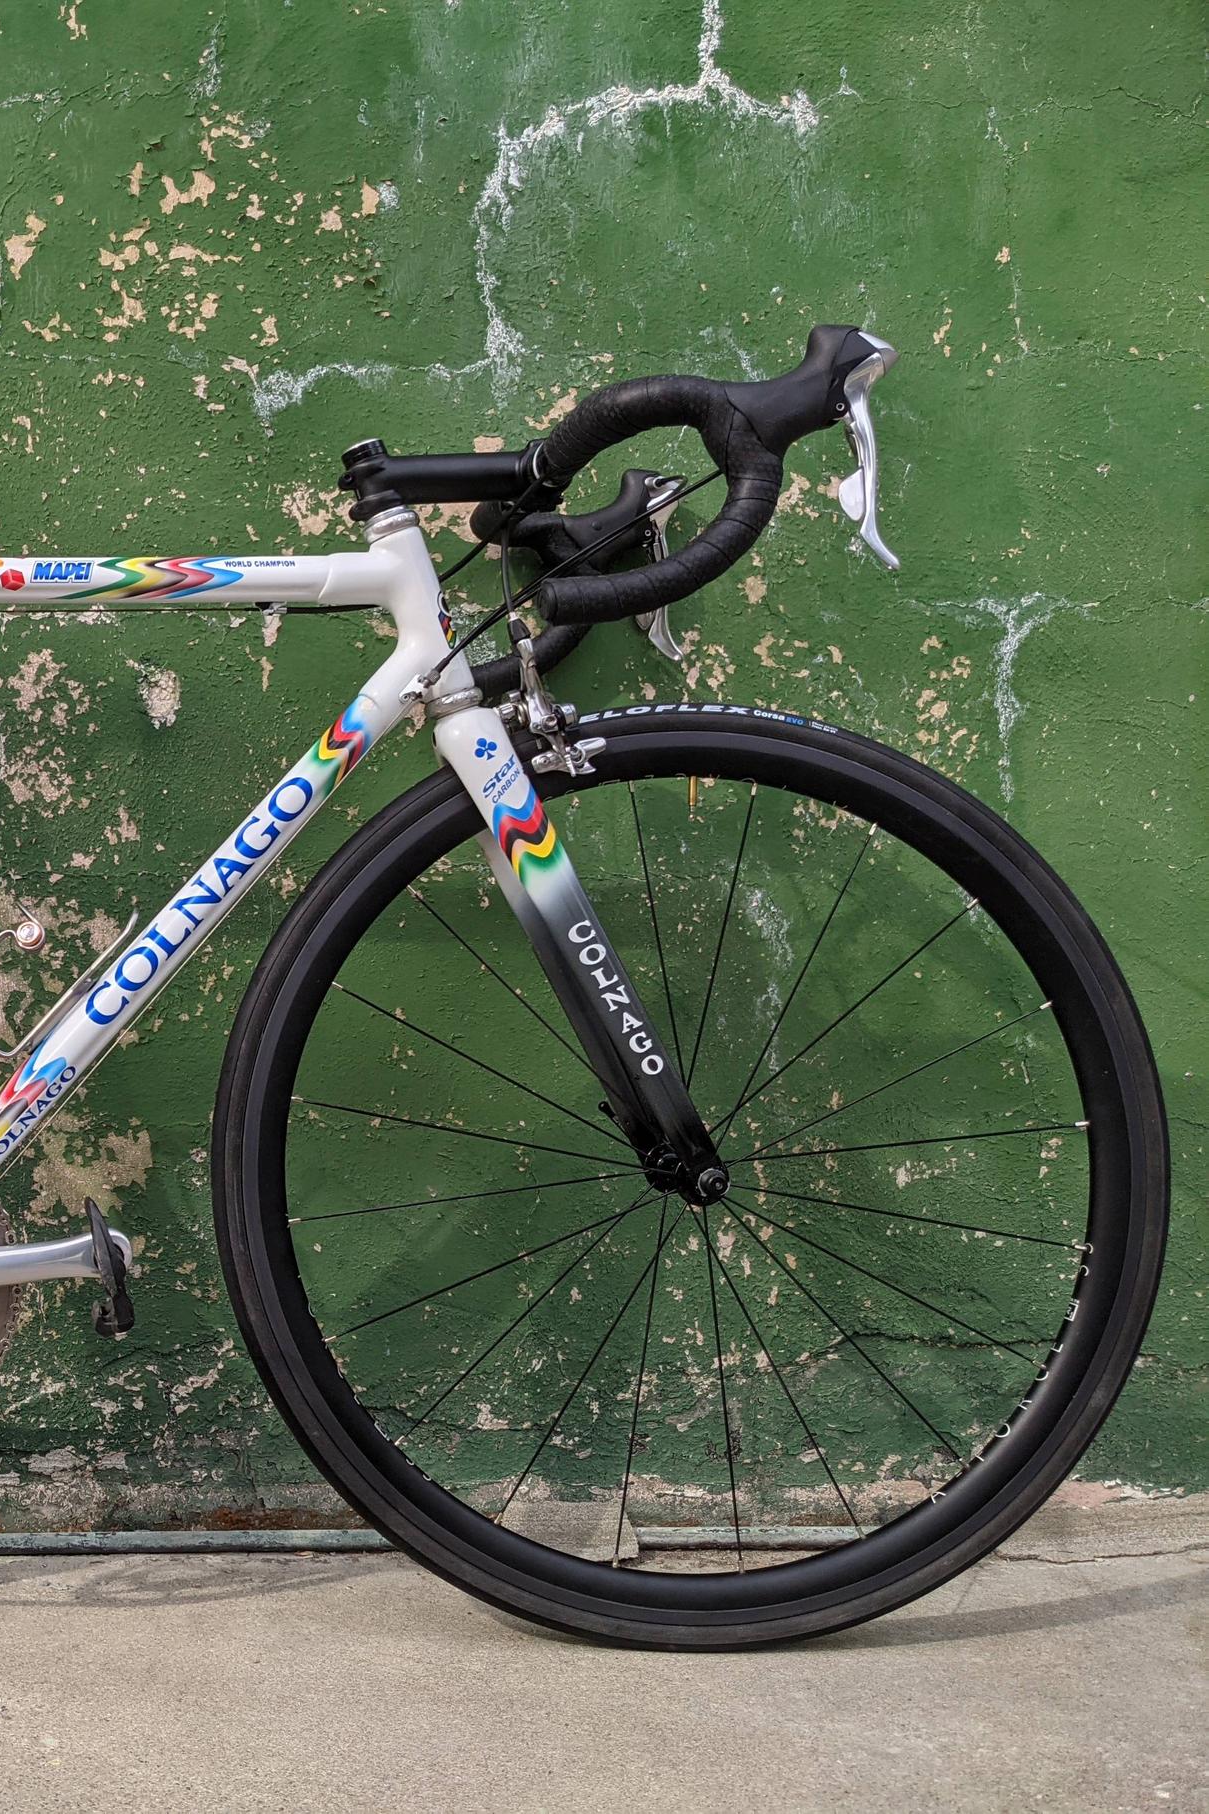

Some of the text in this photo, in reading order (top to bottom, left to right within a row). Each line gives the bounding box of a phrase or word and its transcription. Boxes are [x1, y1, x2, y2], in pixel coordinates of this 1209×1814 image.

[32, 561, 92, 581] MAPEI
[224, 560, 296, 568] WORLD CHAMPION
[579, 704, 804, 726] ELOFLEX Corsa EVO
[483, 754, 515, 798] Star
[492, 768, 520, 804] CARBON
[85, 777, 314, 1025] COLNAGO
[568, 920, 664, 1075] COLNAGO
